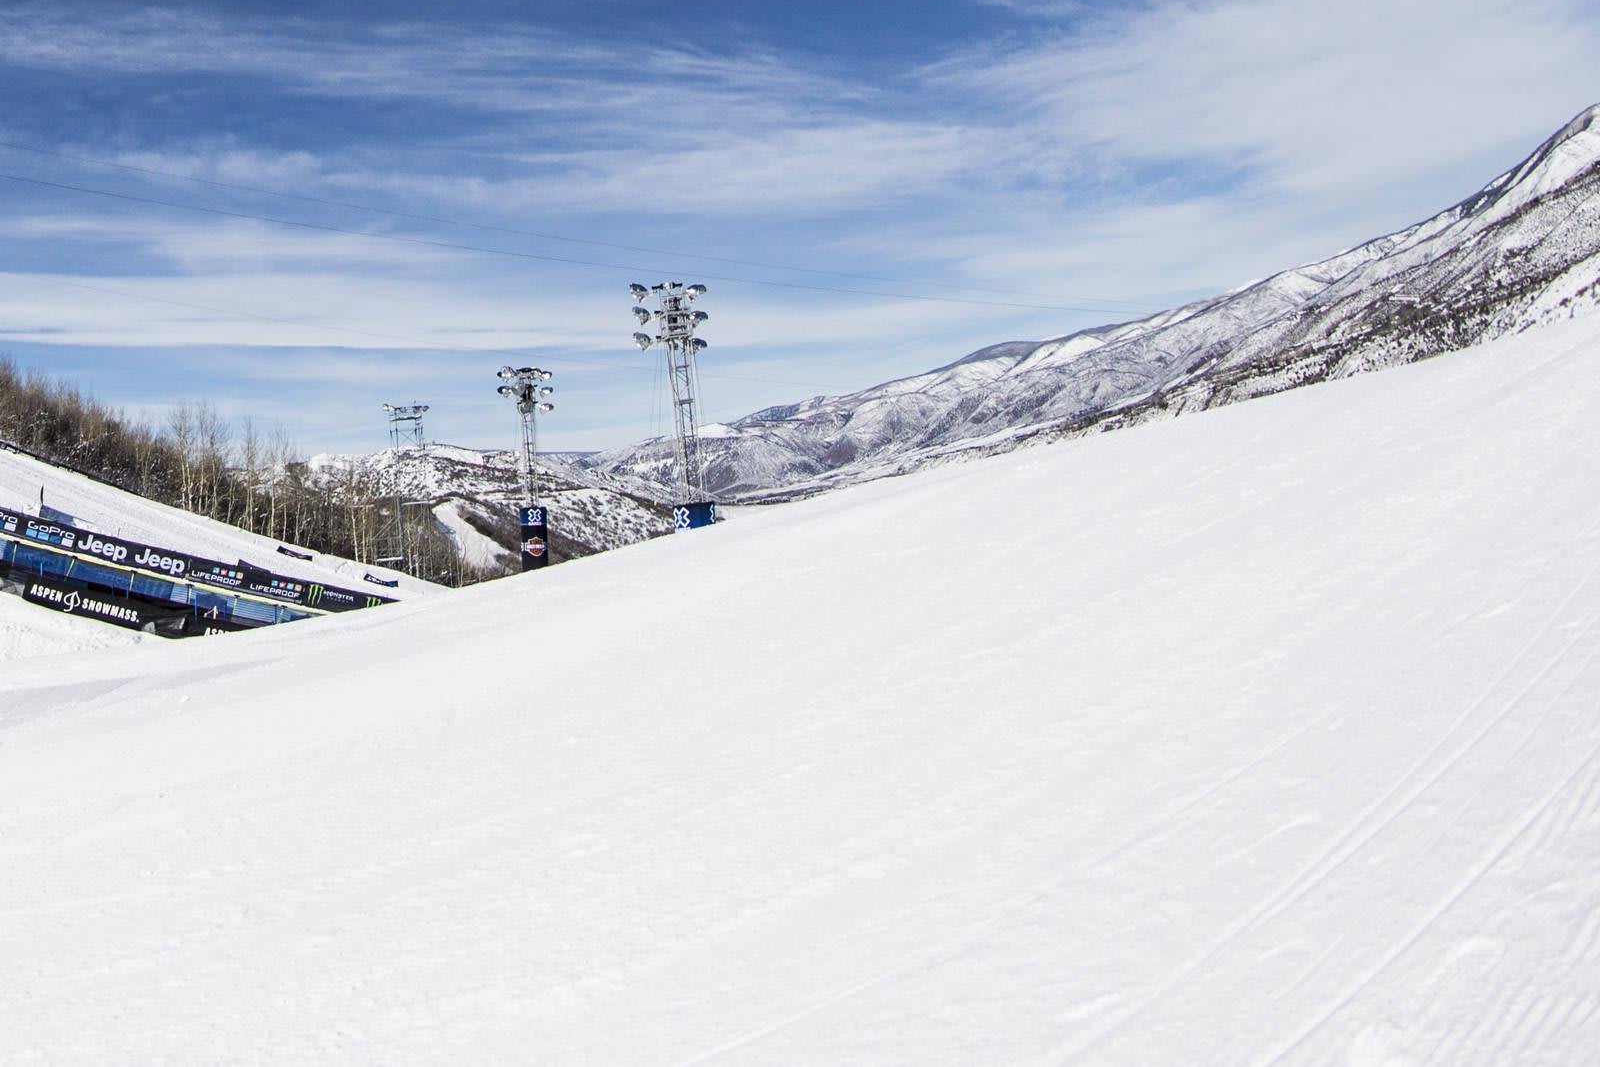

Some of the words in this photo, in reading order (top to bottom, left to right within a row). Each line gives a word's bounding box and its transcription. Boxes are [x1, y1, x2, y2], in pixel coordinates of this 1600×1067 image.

[27, 520, 75, 540] GoPro
[78, 534, 127, 562] Jeep
[135, 549, 185, 575] Jeep
[191, 569, 242, 586] LIFEPROOF
[30, 583, 63, 603] ASPEN
[249, 583, 300, 599] LIFEPROOF
